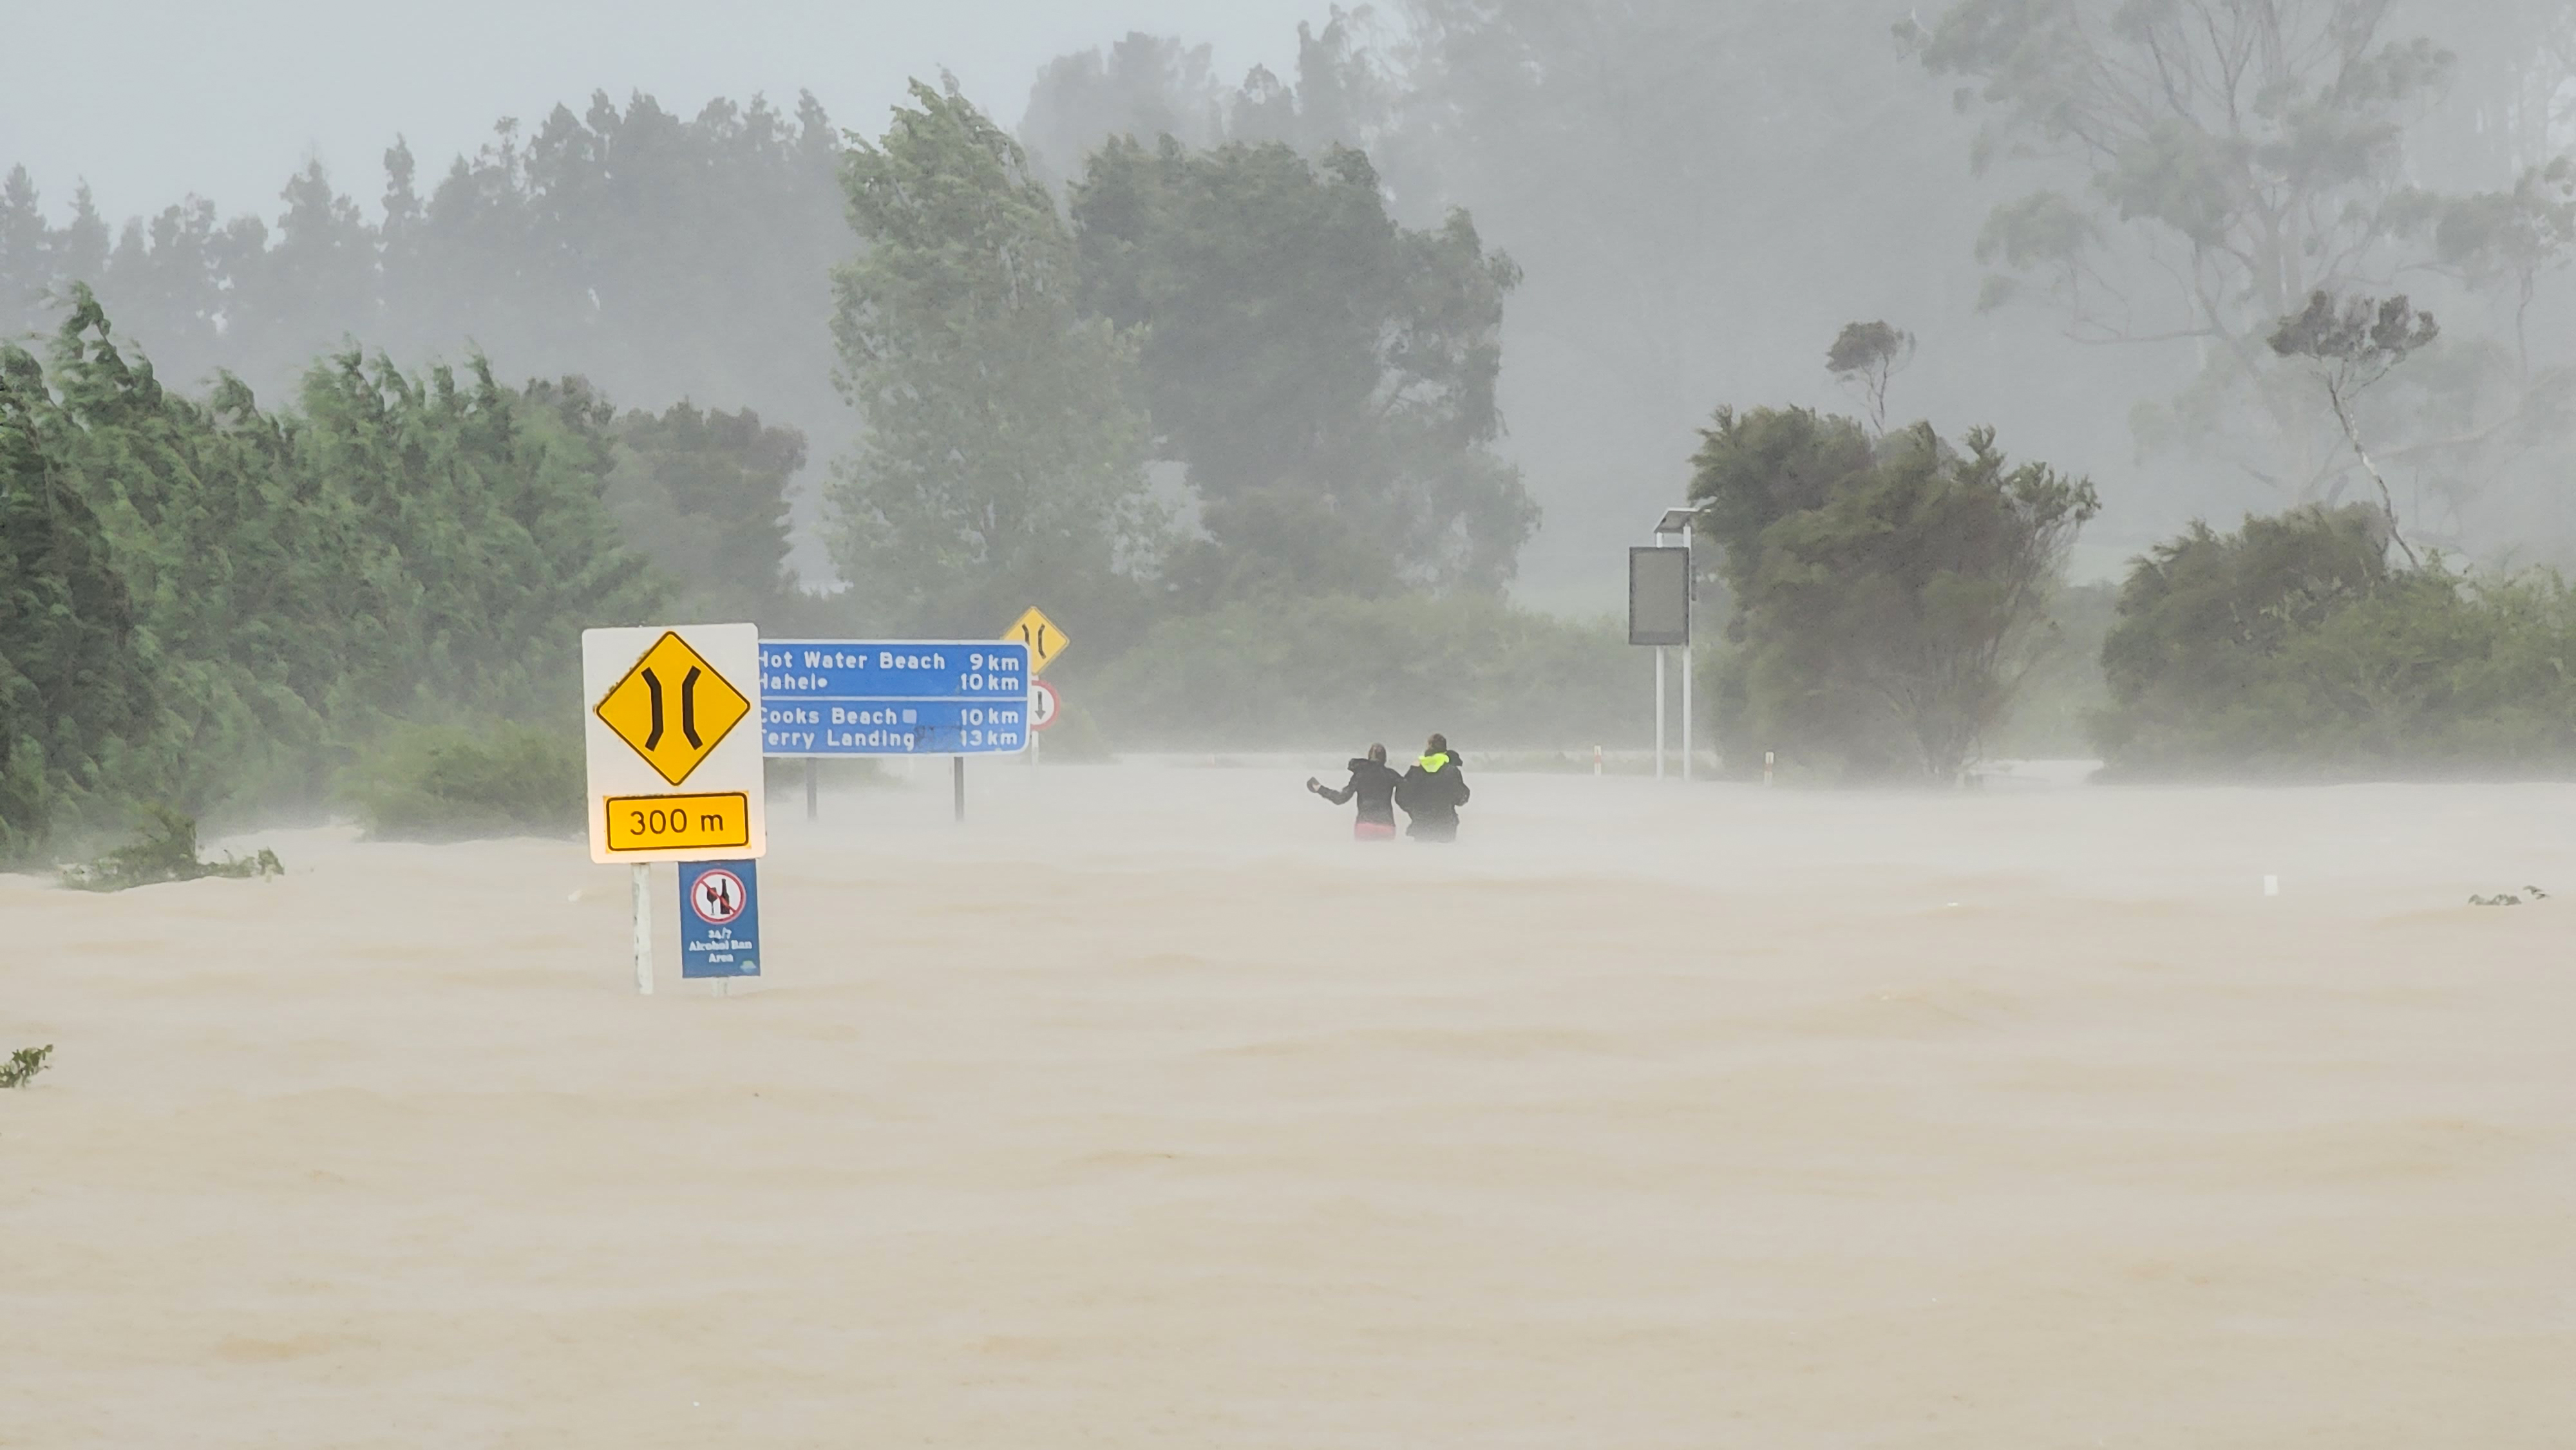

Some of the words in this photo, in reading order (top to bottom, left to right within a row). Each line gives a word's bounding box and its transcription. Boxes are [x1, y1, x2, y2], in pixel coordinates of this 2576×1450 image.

[759, 650, 793, 668] Hot
[804, 651, 867, 669] Water
[880, 652, 945, 670] Beach
[970, 653, 983, 670] 9
[988, 654, 1019, 671] km
[960, 673, 983, 691] 10
[988, 673, 1019, 691] km
[832, 707, 897, 725] Beach
[961, 709, 983, 726] 10
[989, 708, 1019, 724] km
[762, 729, 815, 750] erry
[827, 729, 914, 751] Landing
[960, 730, 983, 747] 13
[987, 730, 1018, 746] km
[630, 808, 687, 836] 300
[701, 814, 723, 832] m
[688, 940, 730, 951] Alcohol
[731, 940, 753, 950] Ban
[708, 953, 734, 963] Area
